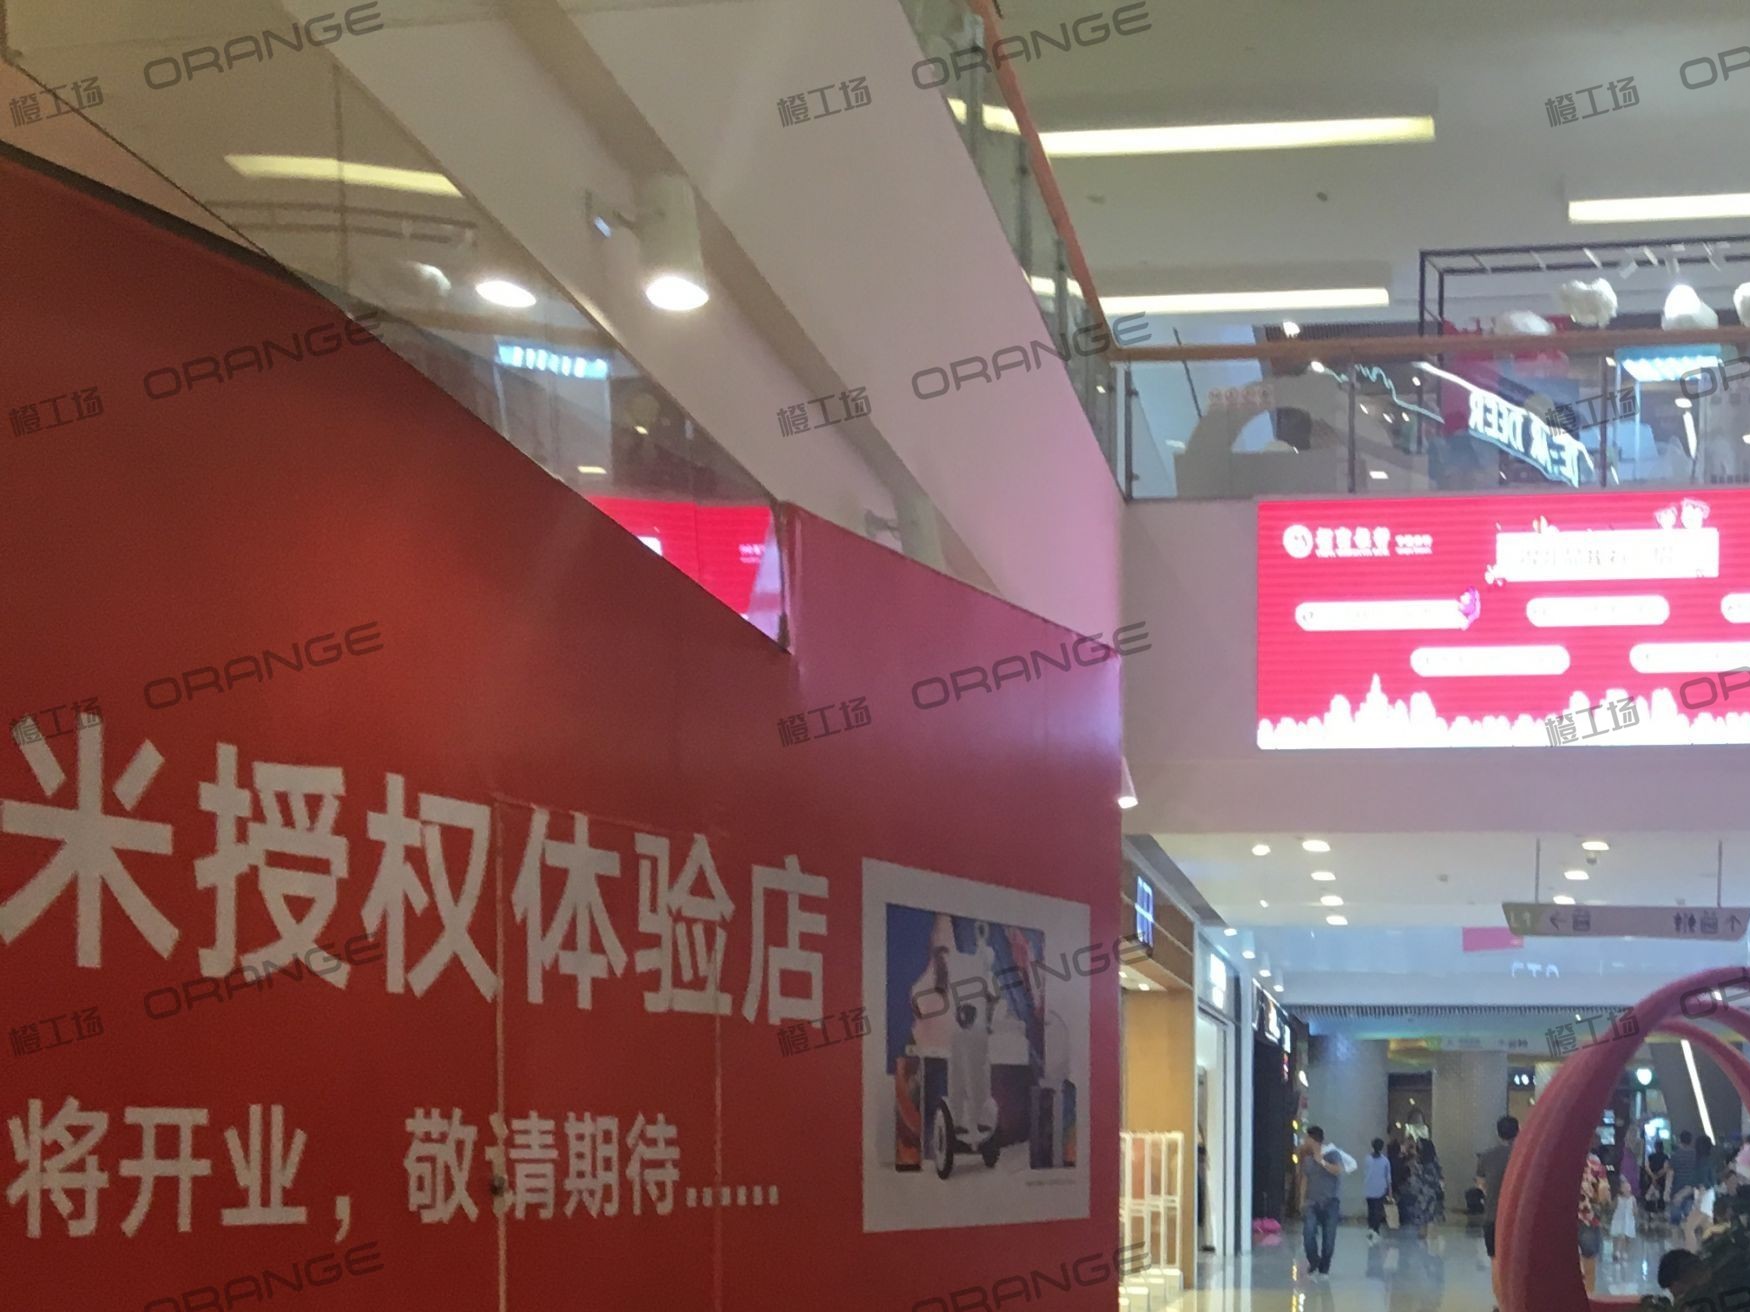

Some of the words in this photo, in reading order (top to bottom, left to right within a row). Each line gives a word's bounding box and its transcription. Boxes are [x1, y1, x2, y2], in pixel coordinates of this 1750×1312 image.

[0, 711, 831, 1029] 米授权体验店
